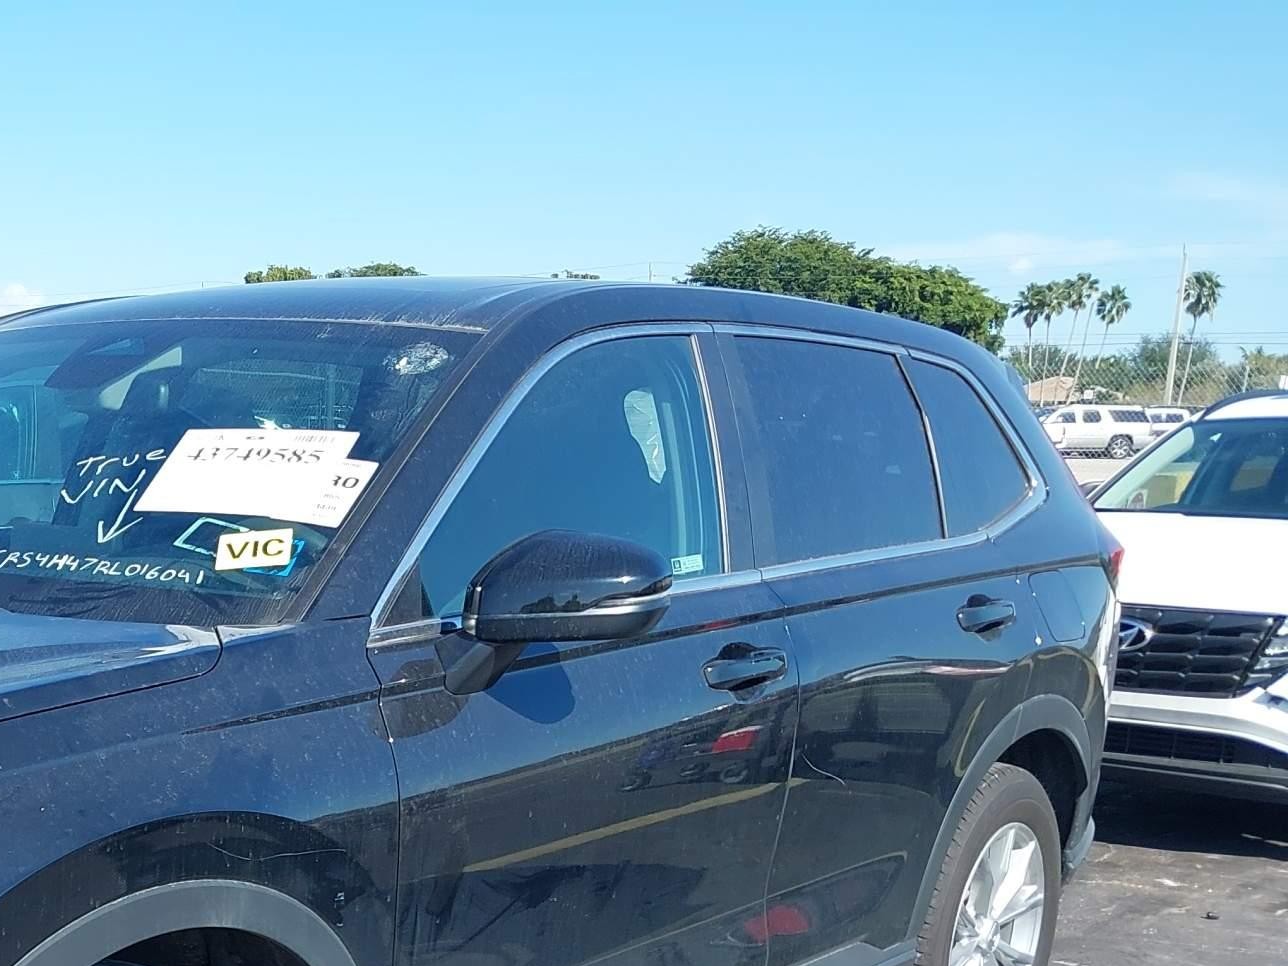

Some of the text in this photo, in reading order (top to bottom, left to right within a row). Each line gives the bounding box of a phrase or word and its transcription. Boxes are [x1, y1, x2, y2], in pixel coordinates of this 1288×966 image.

[187, 447, 325, 464] 43749585
[60, 468, 146, 504] VIN
[226, 538, 285, 559] VIC
